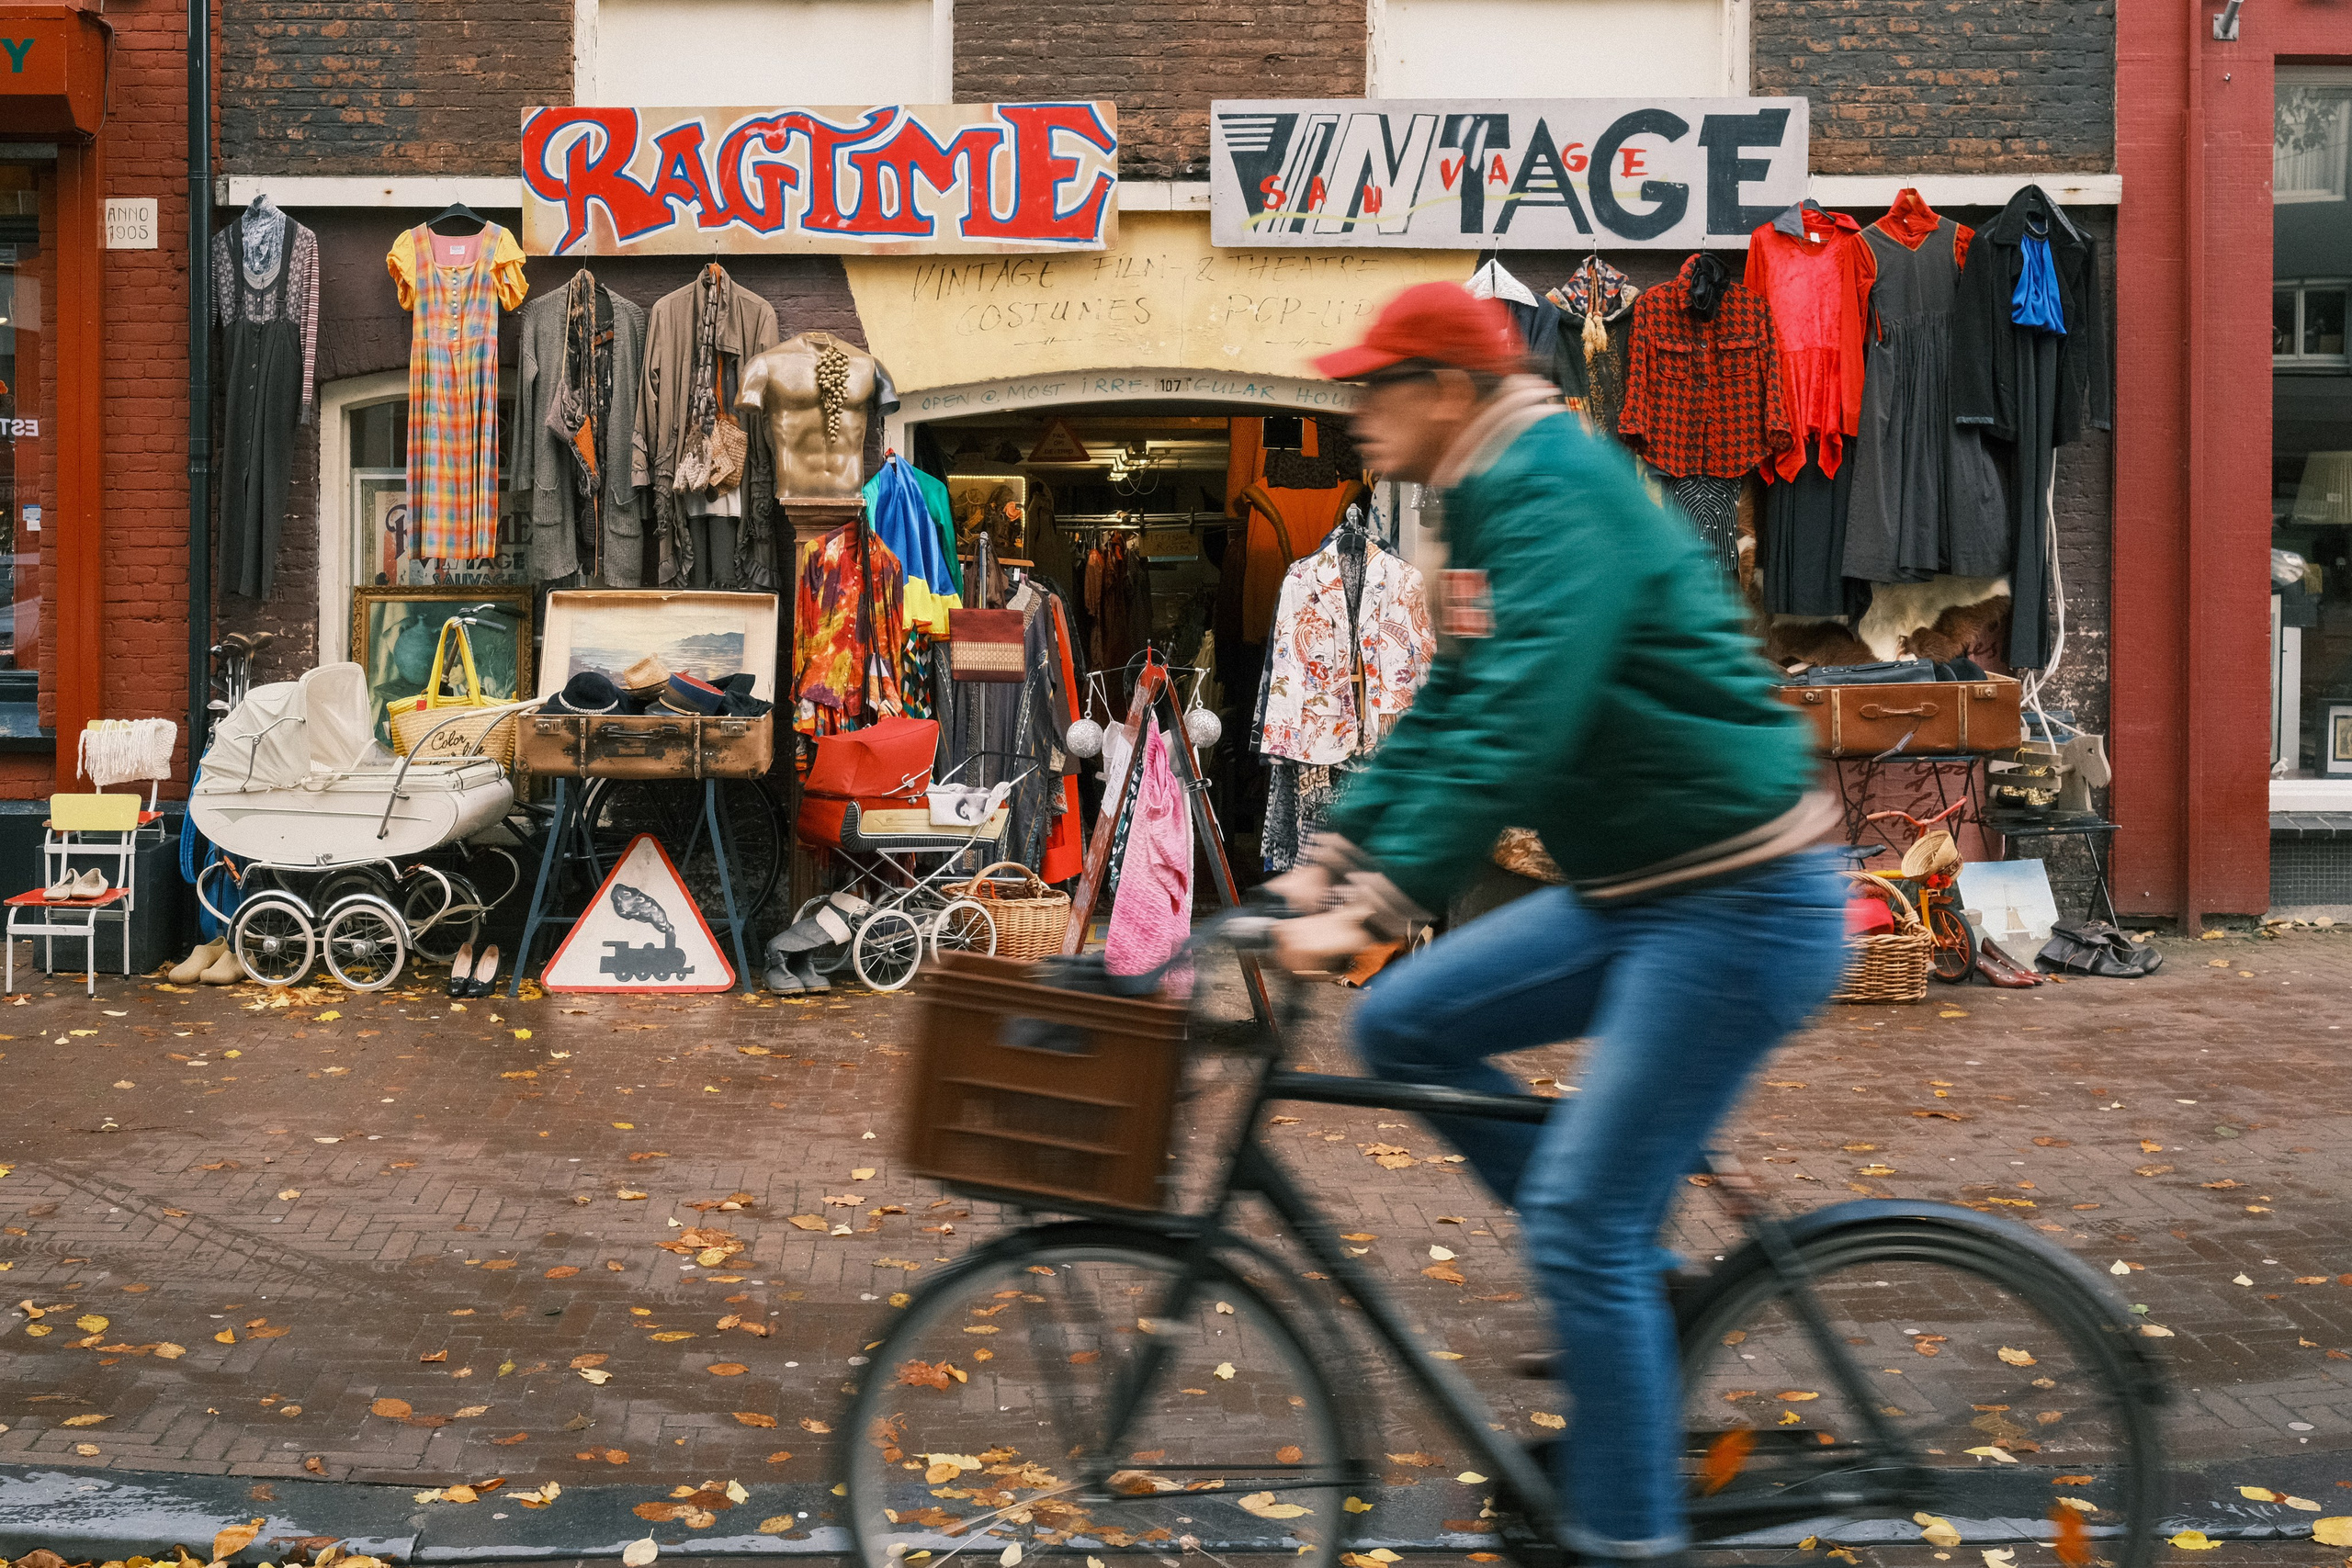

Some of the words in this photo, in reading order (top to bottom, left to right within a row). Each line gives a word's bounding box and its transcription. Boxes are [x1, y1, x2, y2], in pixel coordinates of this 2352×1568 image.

[0, 39, 35, 73] Y
[522, 104, 1116, 255] RAGTIME
[1217, 108, 1791, 241] VINTAGE
[107, 208, 148, 221] ANNO
[107, 225, 148, 240] 1905
[913, 258, 1067, 301] VINTAGE
[1227, 254, 1379, 282] THEATRE
[956, 297, 1151, 336] COSTUMES
[922, 396, 970, 411] OPEN
[1007, 382, 1066, 401] MOST
[1194, 378, 1275, 400] GULAR
[1160, 378, 1182, 392] 107
[433, 573, 518, 586] SAUVAGE
[432, 730, 467, 750] Color
